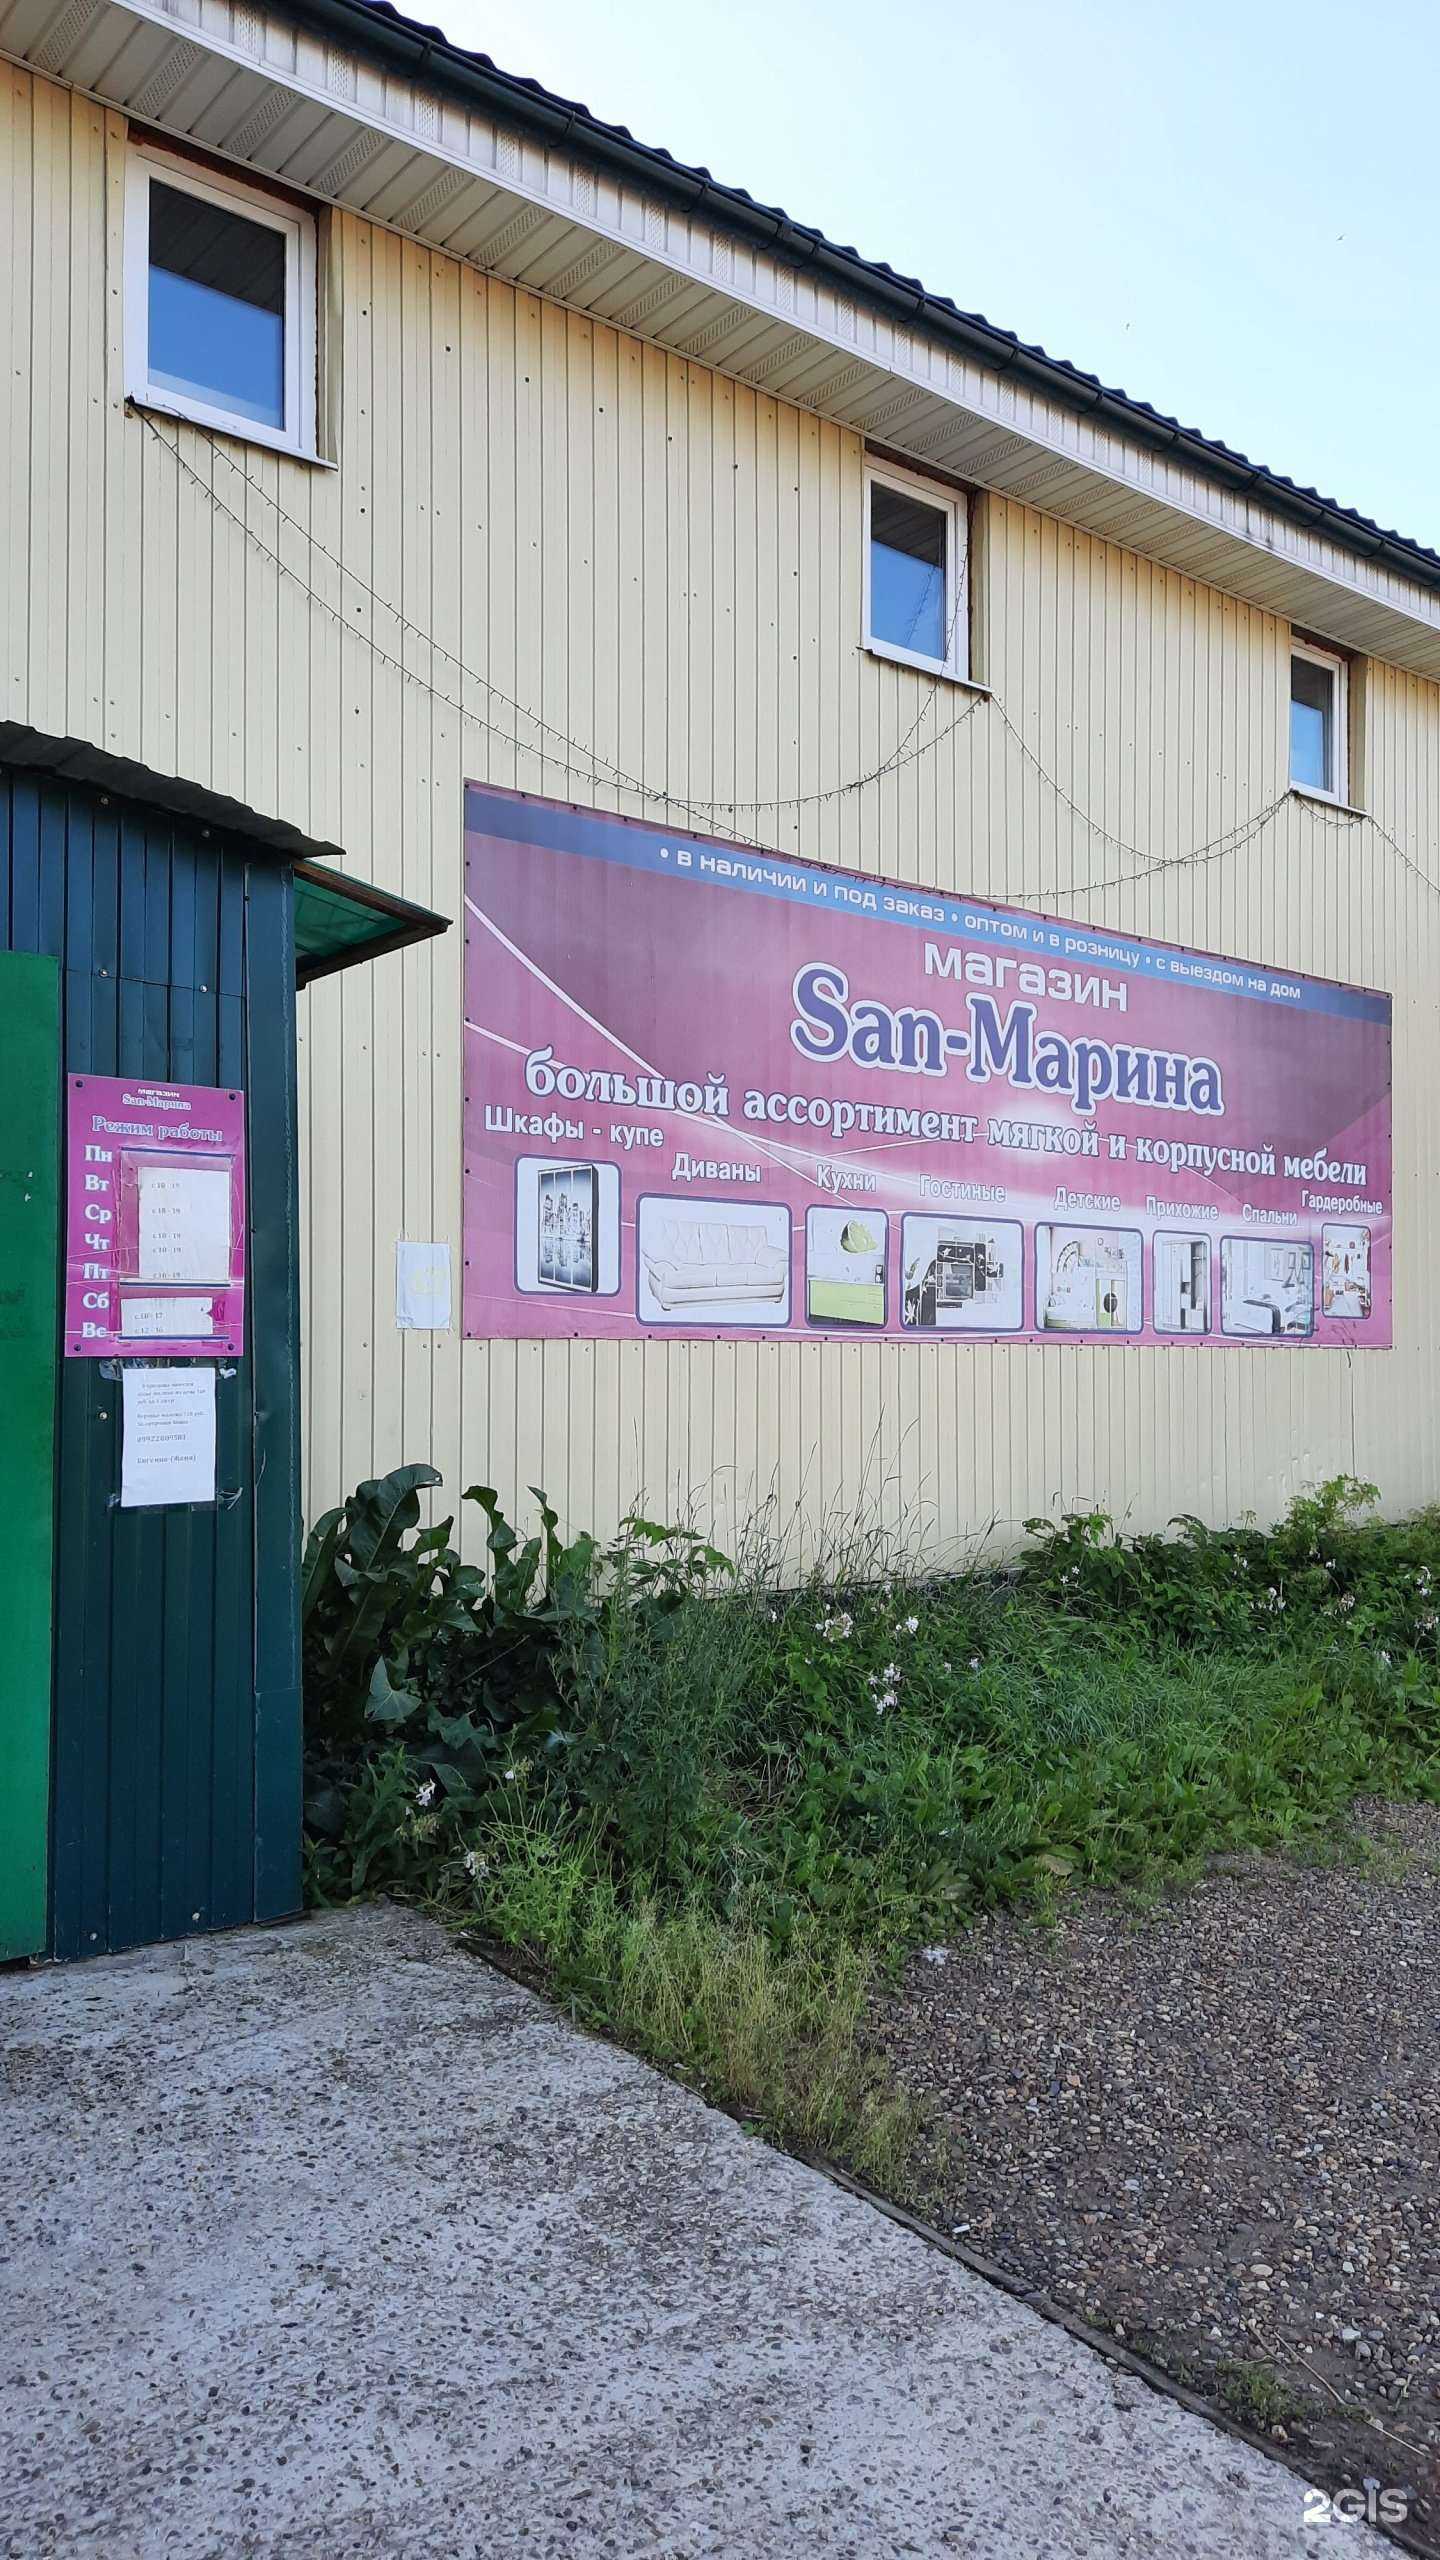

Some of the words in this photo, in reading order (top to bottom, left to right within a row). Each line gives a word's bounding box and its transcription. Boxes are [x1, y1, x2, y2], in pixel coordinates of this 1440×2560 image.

[699, 854, 807, 892] наличии
[813, 880, 828, 897] и
[834, 885, 877, 912] под
[883, 896, 945, 922] заказ
[965, 915, 1027, 940] оптом
[1032, 931, 1044, 944] и
[1065, 937, 1140, 968] розницу
[1156, 957, 1167, 970] с
[1170, 961, 1244, 988] выездом
[1248, 977, 1267, 992] на
[1270, 983, 1301, 1000] дом
[924, 942, 1128, 1012] магазин
[789, 962, 1225, 1117] San-Марина
[484, 1104, 584, 1143] Шкафы
[609, 1120, 664, 1150] купе
[524, 1044, 730, 1117] большой
[742, 1089, 978, 1143] ассортимент
[987, 1119, 1099, 1157] мягкой
[1108, 1133, 1127, 1160] и
[1136, 1143, 1277, 1177] корпусной
[1283, 1148, 1367, 1186] мебели
[91, 1115, 154, 1137] Режим
[158, 1122, 224, 1142] работы
[84, 1144, 113, 1163] Пн
[671, 1152, 761, 1183] Диваны
[816, 1164, 877, 1193] Кухни
[84, 1174, 110, 1192] Вт
[919, 1174, 1008, 1202] Гостиные
[1053, 1186, 1121, 1212] Детские
[1145, 1195, 1219, 1221] Прихожие
[1301, 1189, 1383, 1216] Гардеробные
[84, 1204, 112, 1224] Ср
[1242, 1203, 1298, 1225] Спальни
[84, 1232, 110, 1250] Чт
[83, 1263, 110, 1280] Пт
[82, 1291, 110, 1309] Сб
[81, 1322, 108, 1339] Вс
